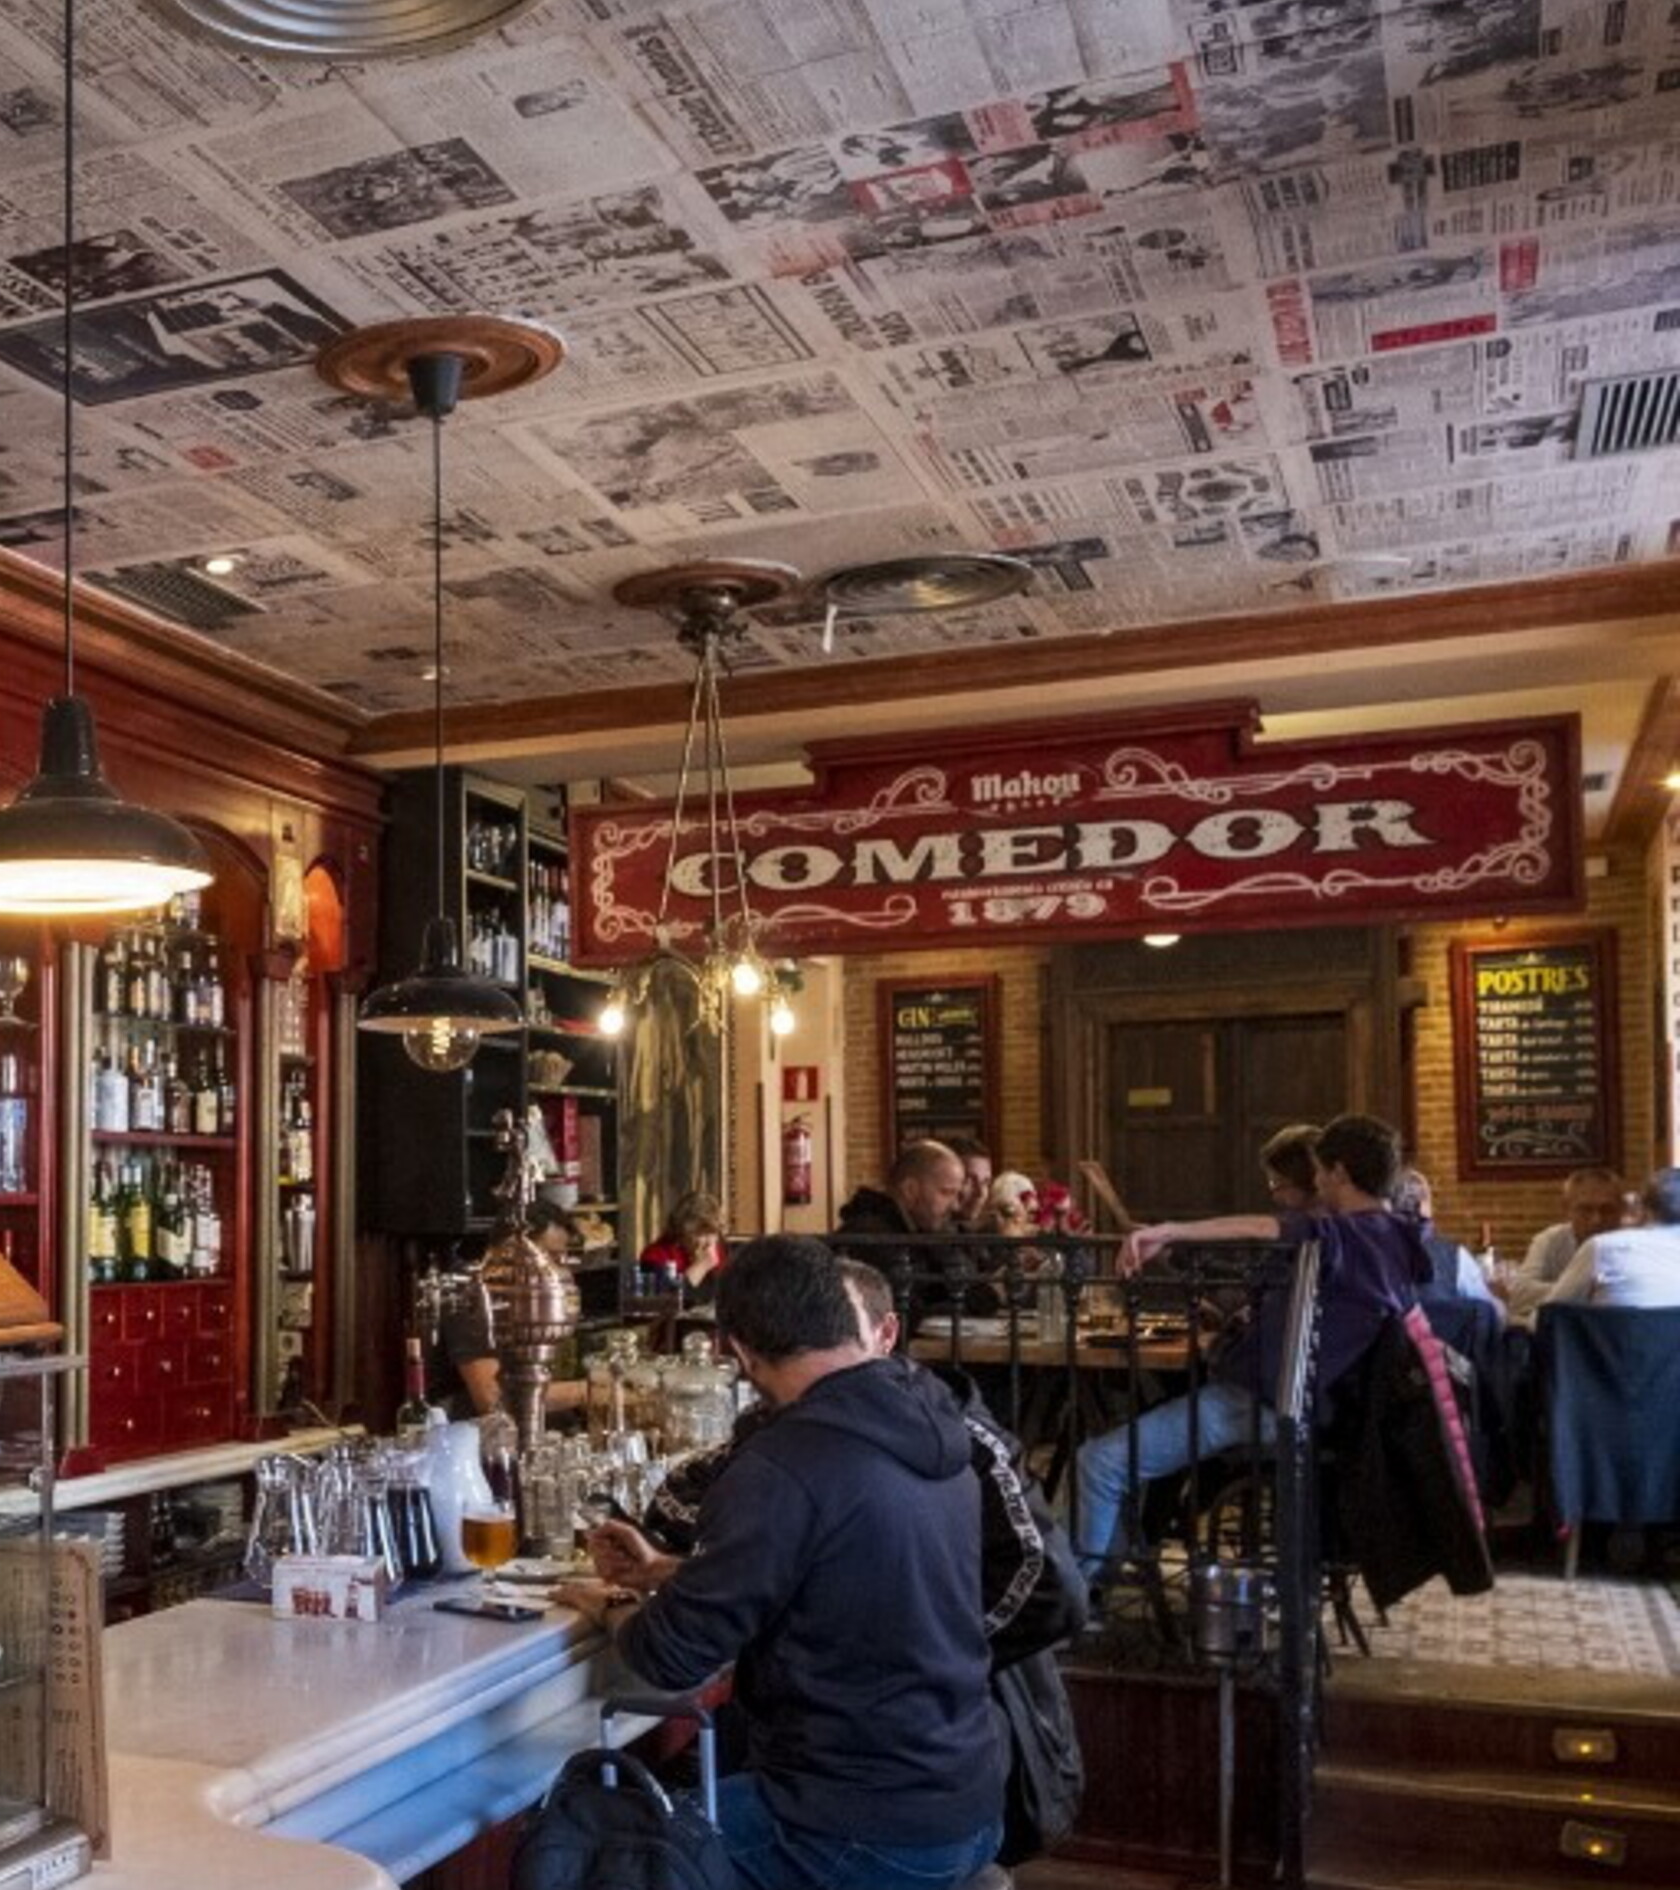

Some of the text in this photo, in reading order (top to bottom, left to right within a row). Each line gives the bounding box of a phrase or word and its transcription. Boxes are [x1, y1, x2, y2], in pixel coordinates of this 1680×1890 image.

[971, 769, 1081, 802] Mahou
[670, 799, 1436, 897] COMEDOR
[948, 892, 1108, 927] 1879
[1477, 965, 1590, 996] POSTRES
